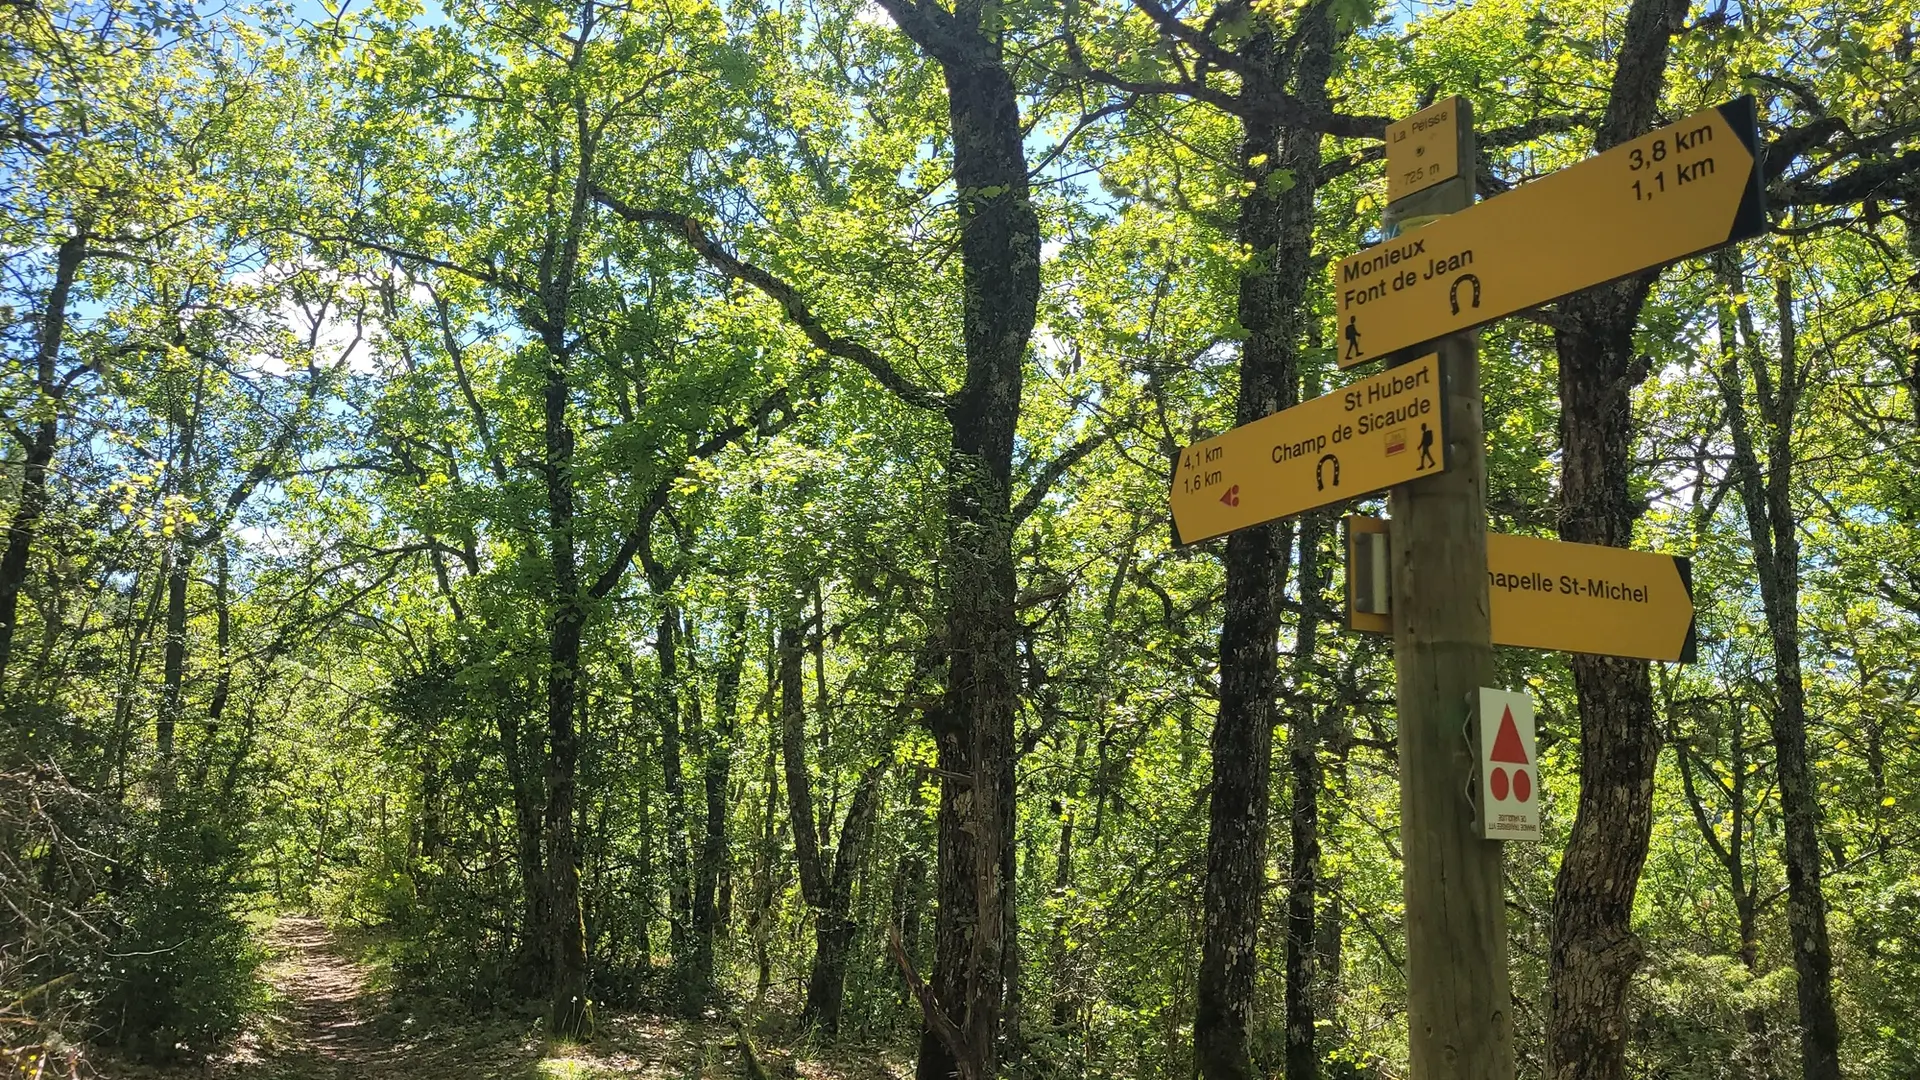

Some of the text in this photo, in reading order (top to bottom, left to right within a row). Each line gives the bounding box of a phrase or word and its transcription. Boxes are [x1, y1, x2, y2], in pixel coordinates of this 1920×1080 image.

[1393, 130, 1406, 144] La
[1629, 125, 1713, 171] 3,8 km
[1403, 163, 1440, 185] 725 m
[1631, 157, 1714, 201] 1,1 km
[1343, 239, 1426, 283] Monieux
[1344, 249, 1473, 310] Font de Jean
[1344, 366, 1430, 412] St Hubert
[1271, 396, 1431, 464] Champ de Sicaude
[1184, 444, 1223, 471] 4,1 km
[1184, 468, 1222, 494] 1,6 km
[1488, 571, 1649, 604] apelle St-Michel
